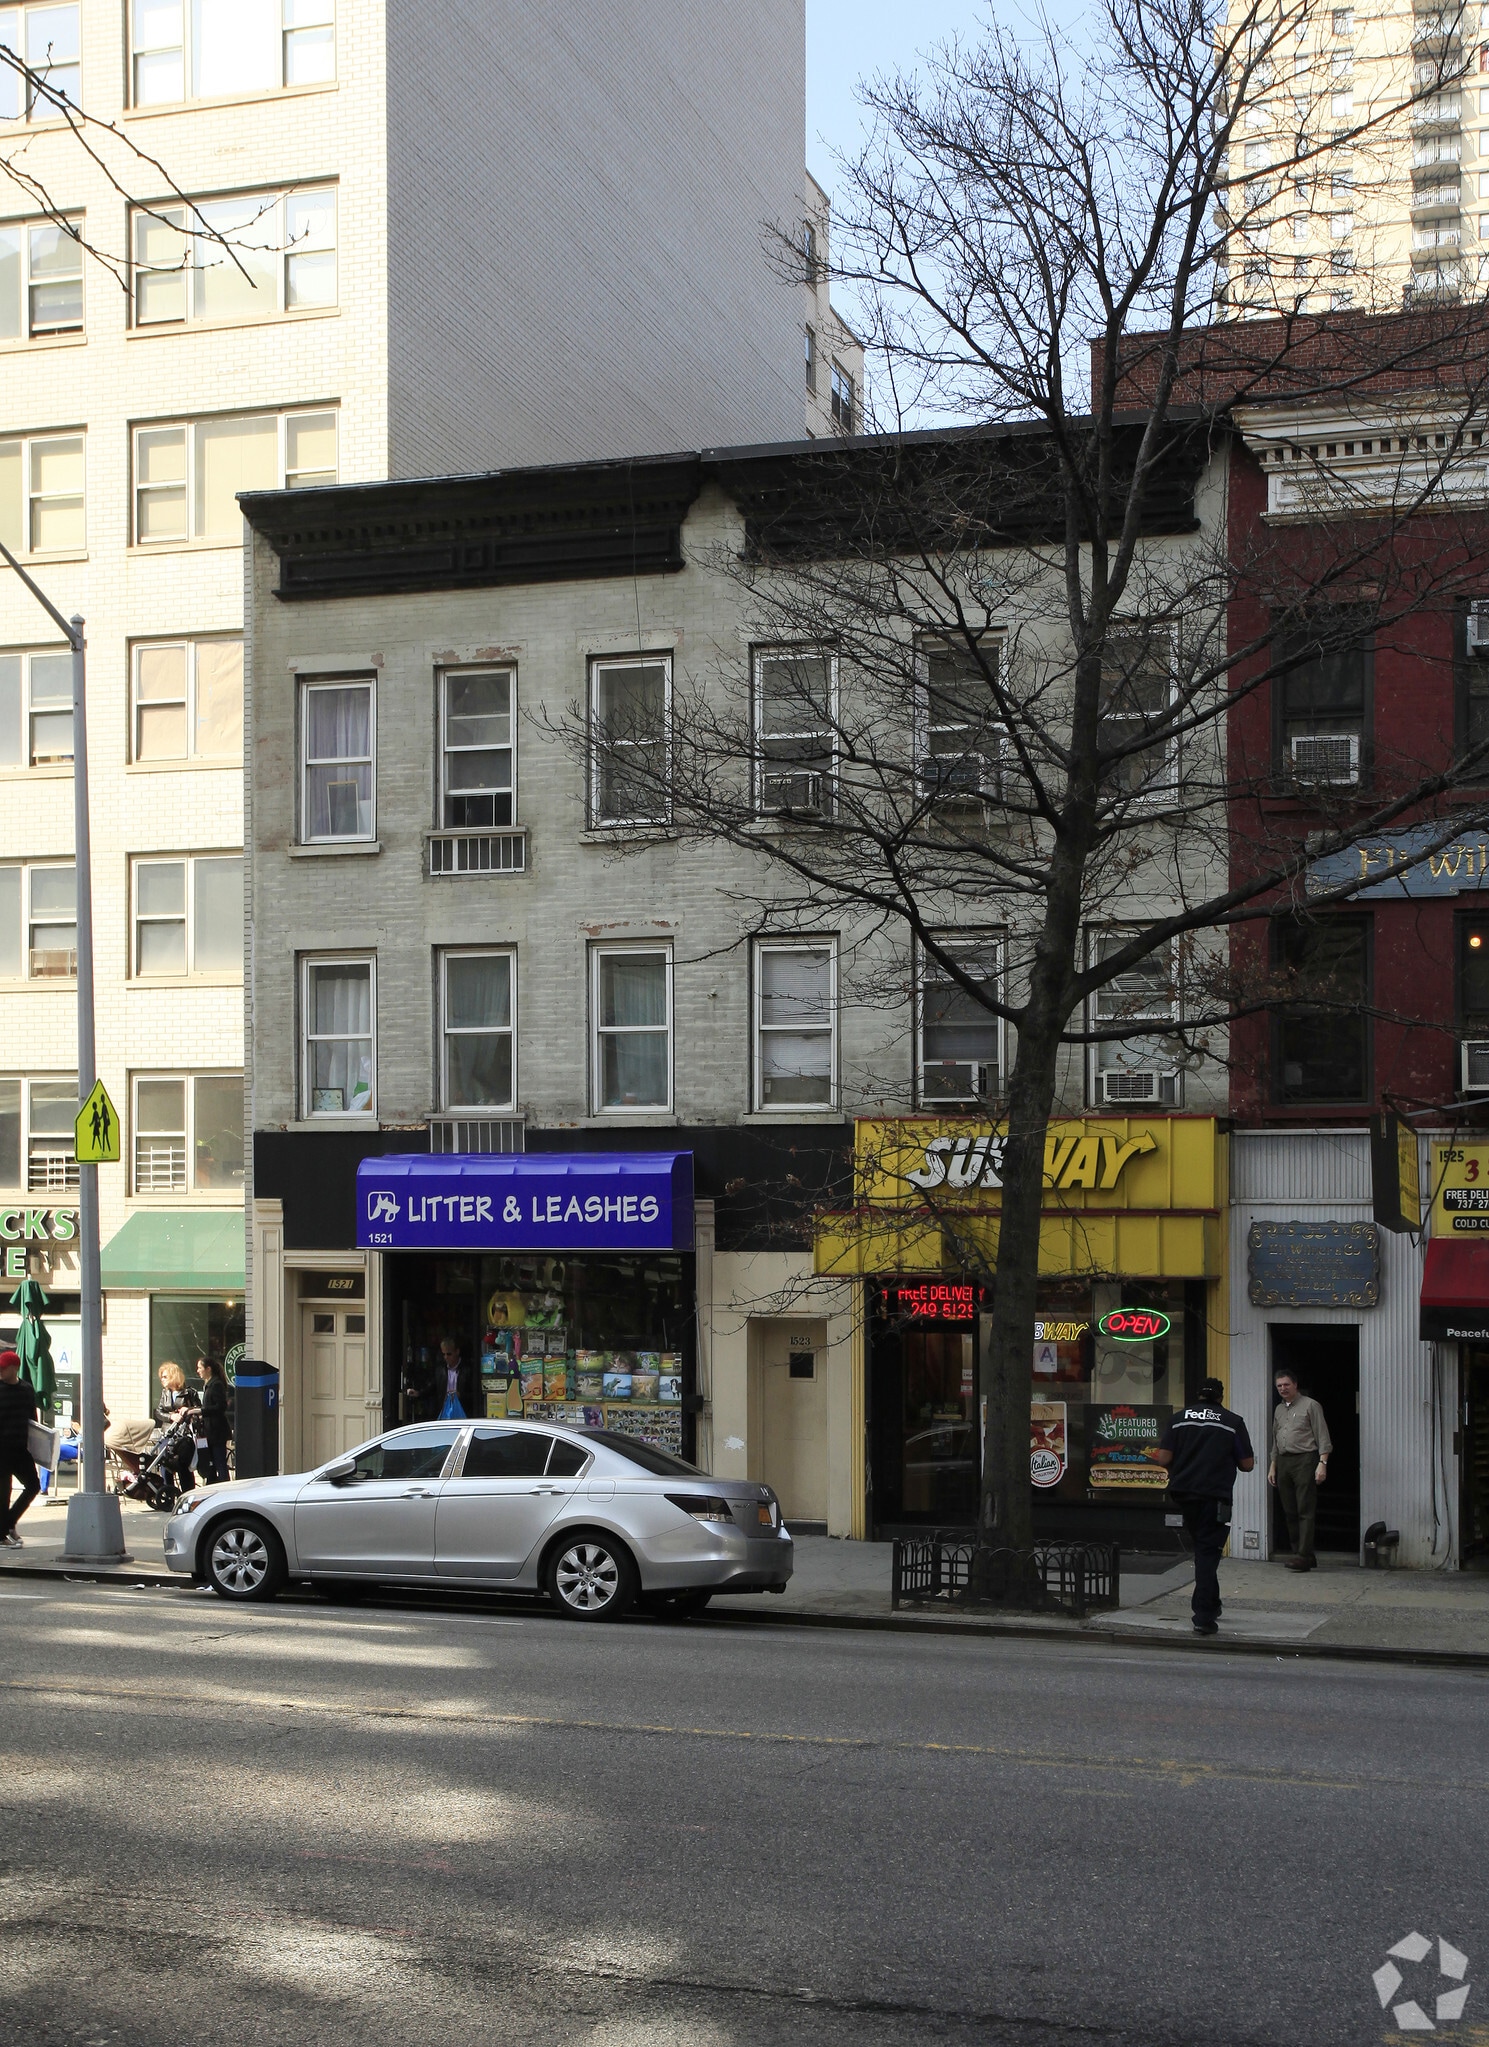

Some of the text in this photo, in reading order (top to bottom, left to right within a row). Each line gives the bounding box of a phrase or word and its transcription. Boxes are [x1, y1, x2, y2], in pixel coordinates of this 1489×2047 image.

[1439, 1150, 1464, 1162] 1525
[1446, 1190, 1468, 1200] FREE
[407, 1195, 660, 1223] LITTER & LEASHES
[1455, 1219, 1478, 1228] COLD
[368, 1232, 394, 1244] 1521
[329, 1280, 353, 1289] 1521
[911, 1302, 937, 1318] 249
[1107, 1313, 1161, 1335] OPEN
[790, 1336, 811, 1346] 1523
[59, 1351, 69, 1364] A
[226, 1345, 247, 1366] STAR
[1040, 1346, 1054, 1362] A
[268, 1388, 275, 1406] P
[1184, 1408, 1222, 1421] FedEx
[1118, 1418, 1157, 1427] FEATURED
[1118, 1428, 1157, 1438] FOOTLONG
[1031, 1454, 1057, 1471] Italian
